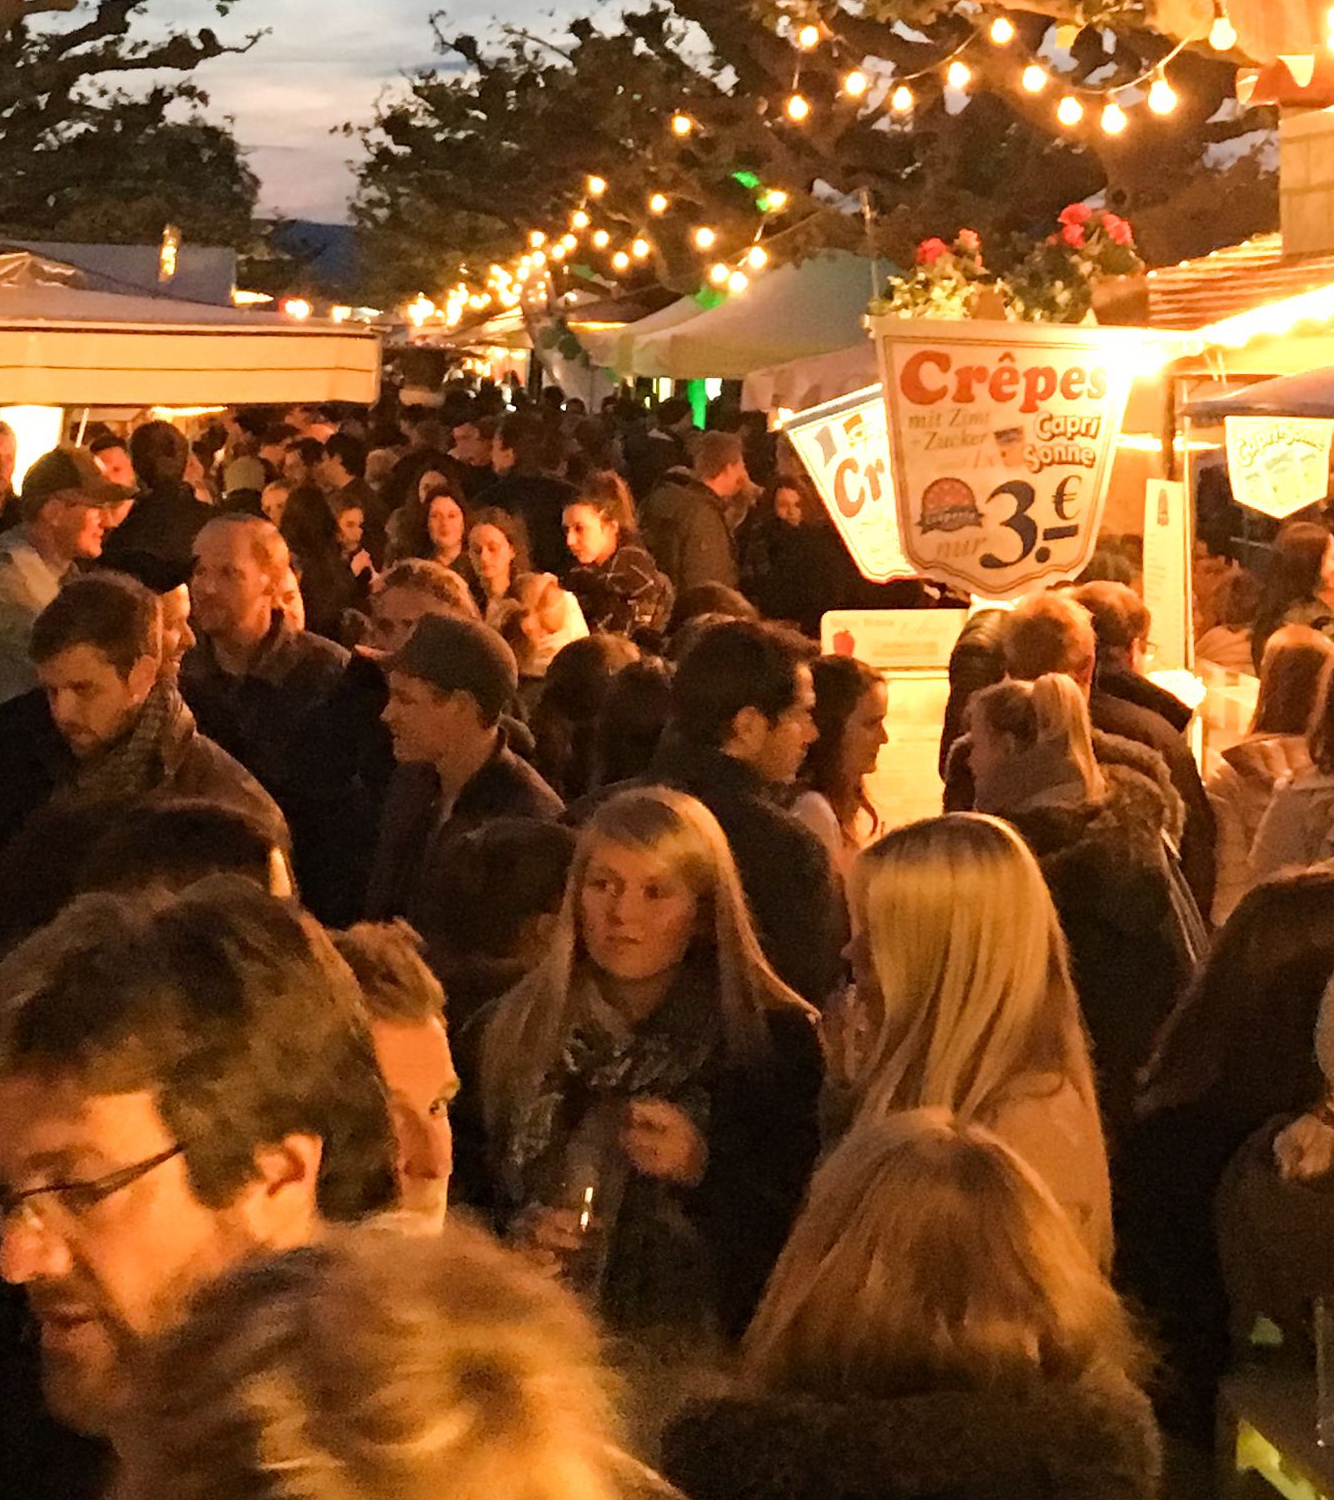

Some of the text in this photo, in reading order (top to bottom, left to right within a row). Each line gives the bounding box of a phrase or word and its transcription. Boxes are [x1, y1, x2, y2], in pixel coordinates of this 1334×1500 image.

[900, 350, 1108, 414] Crêpes
[1033, 411, 1101, 443] Capri
[1023, 443, 1097, 474] Sonne
[833, 457, 886, 519] Cr
